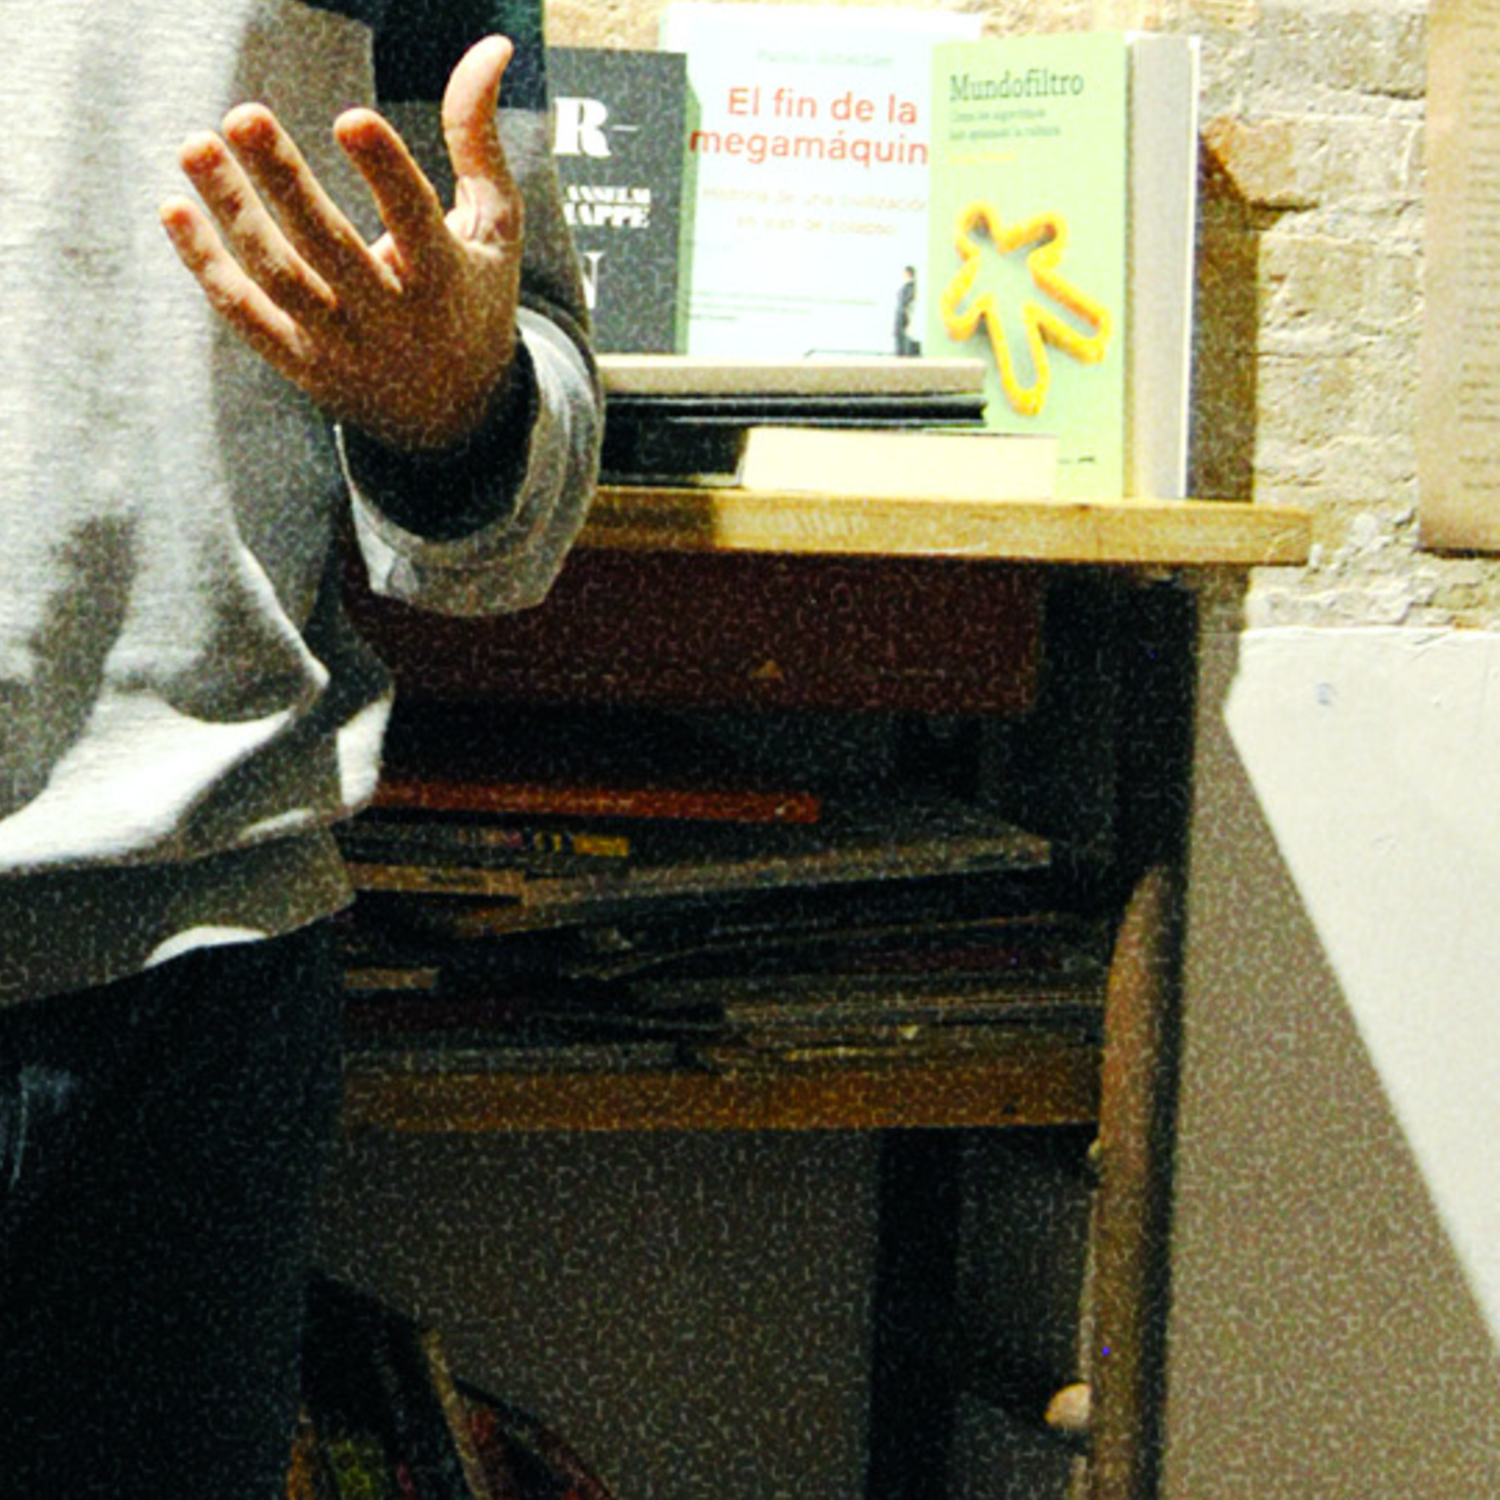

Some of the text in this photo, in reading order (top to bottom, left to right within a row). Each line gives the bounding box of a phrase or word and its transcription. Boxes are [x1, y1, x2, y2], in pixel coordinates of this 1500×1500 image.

[949, 68, 1084, 102] Mundofiltro
[728, 86, 917, 125] El fin de la
